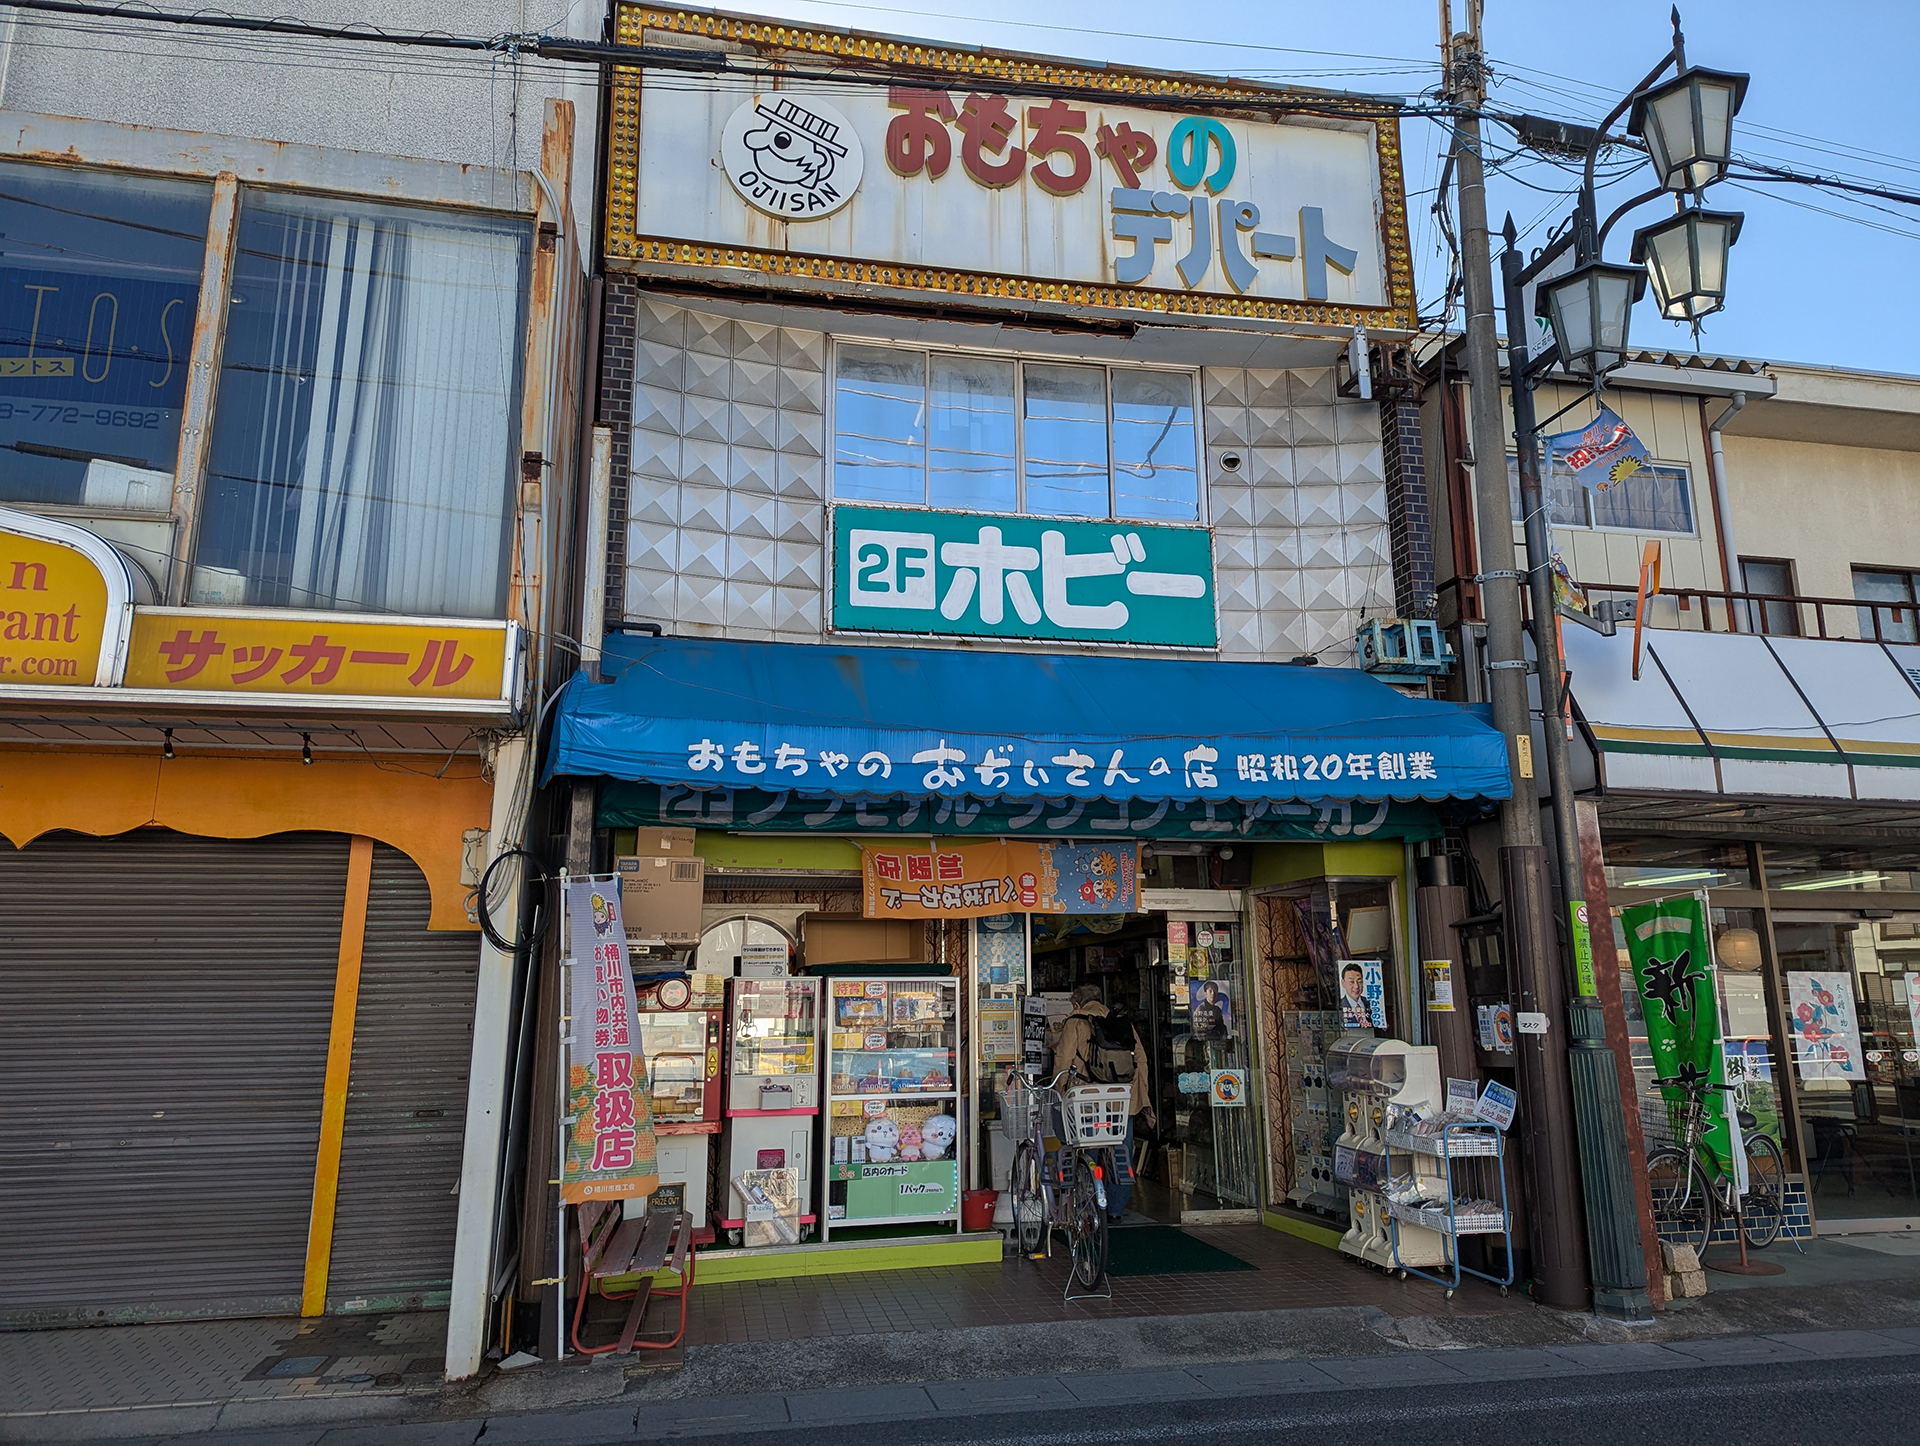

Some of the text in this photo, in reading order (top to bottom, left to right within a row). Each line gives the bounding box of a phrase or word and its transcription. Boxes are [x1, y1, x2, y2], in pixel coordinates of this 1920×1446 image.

[887, 86, 1237, 197] おもちゃの
[738, 171, 843, 214] OJIISAN
[1112, 187, 1358, 302] デパート
[940, 526, 1207, 630] ホビー
[0, 603, 81, 643] ant
[158, 630, 475, 687] サッカール
[875, 854, 964, 881] 加盟店
[881, 876, 1019, 909] べにばなカード
[1578, 938, 1592, 985] 禁止区域
[594, 945, 611, 1047] お買い物券
[604, 943, 630, 1046] 桶川市内共通
[836, 983, 861, 995] 特賞
[1835, 982, 1849, 1028] 冬の贈り物
[591, 1050, 636, 1171] 取扱店
[594, 1183, 636, 1194] 桶川市商工会
[862, 1166, 908, 1177] 店内のカード
[900, 1184, 926, 1194] 1パック
[651, 1197, 667, 1206] PRIZE
